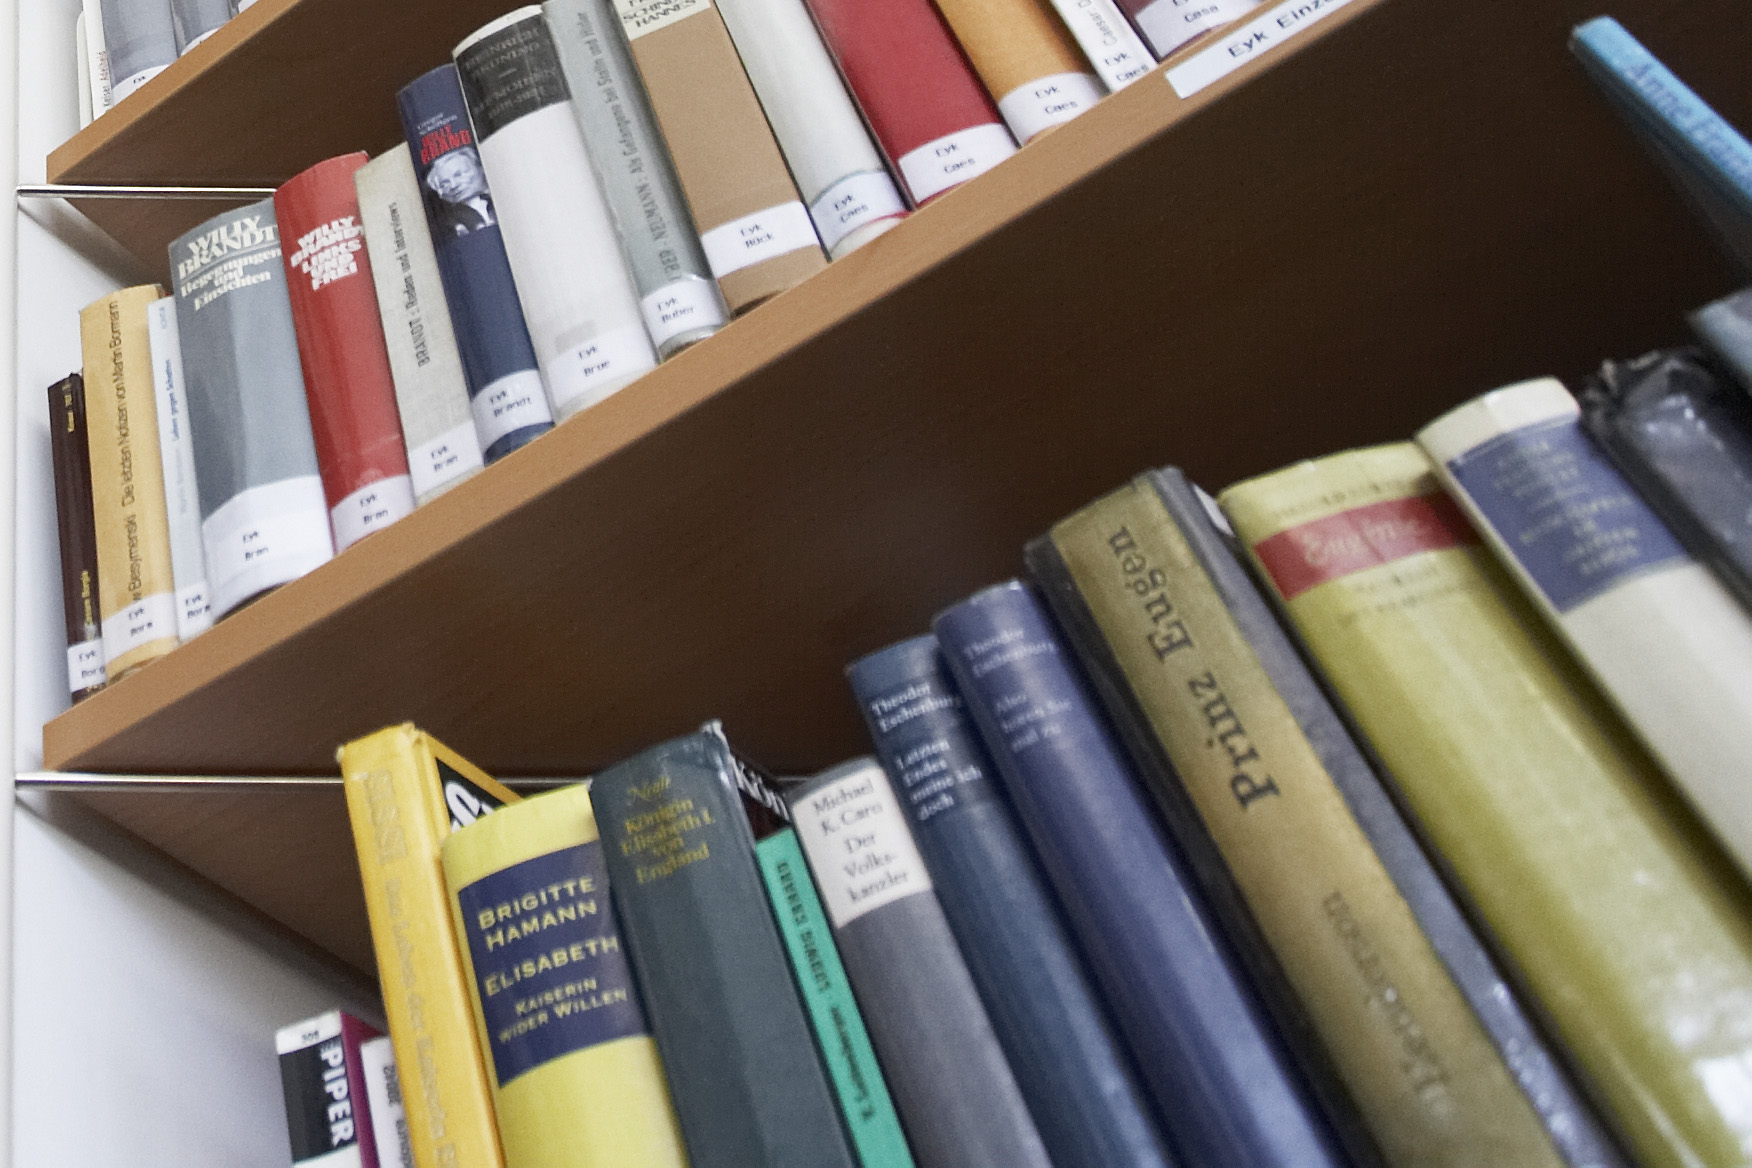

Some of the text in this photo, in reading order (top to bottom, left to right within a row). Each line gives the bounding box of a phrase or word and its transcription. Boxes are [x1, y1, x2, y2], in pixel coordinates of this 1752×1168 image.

[1224, 25, 1270, 61] Eyk
[177, 224, 278, 280] BRANDT
[188, 215, 262, 256] WILLY
[297, 215, 355, 250] WILLY
[311, 261, 358, 292] FREI
[384, 200, 433, 367] BRANDT Reden und Interviews
[106, 299, 123, 347] Bormann
[110, 345, 125, 382] Martin
[115, 381, 127, 401] von
[114, 401, 131, 445] Notizen
[117, 444, 134, 483] letzten
[120, 482, 135, 507] Die
[1105, 524, 1282, 811] Prinz Eugen
[812, 777, 876, 816] Michael
[844, 832, 877, 854] Der
[476, 875, 597, 931] BRIGITTE
[485, 899, 598, 954] HAMANN
[483, 936, 620, 998] ELISABETH
[513, 977, 598, 1016] KAISERIN
[553, 987, 628, 1020] WILLEN
[319, 1047, 355, 1148] PIPER
